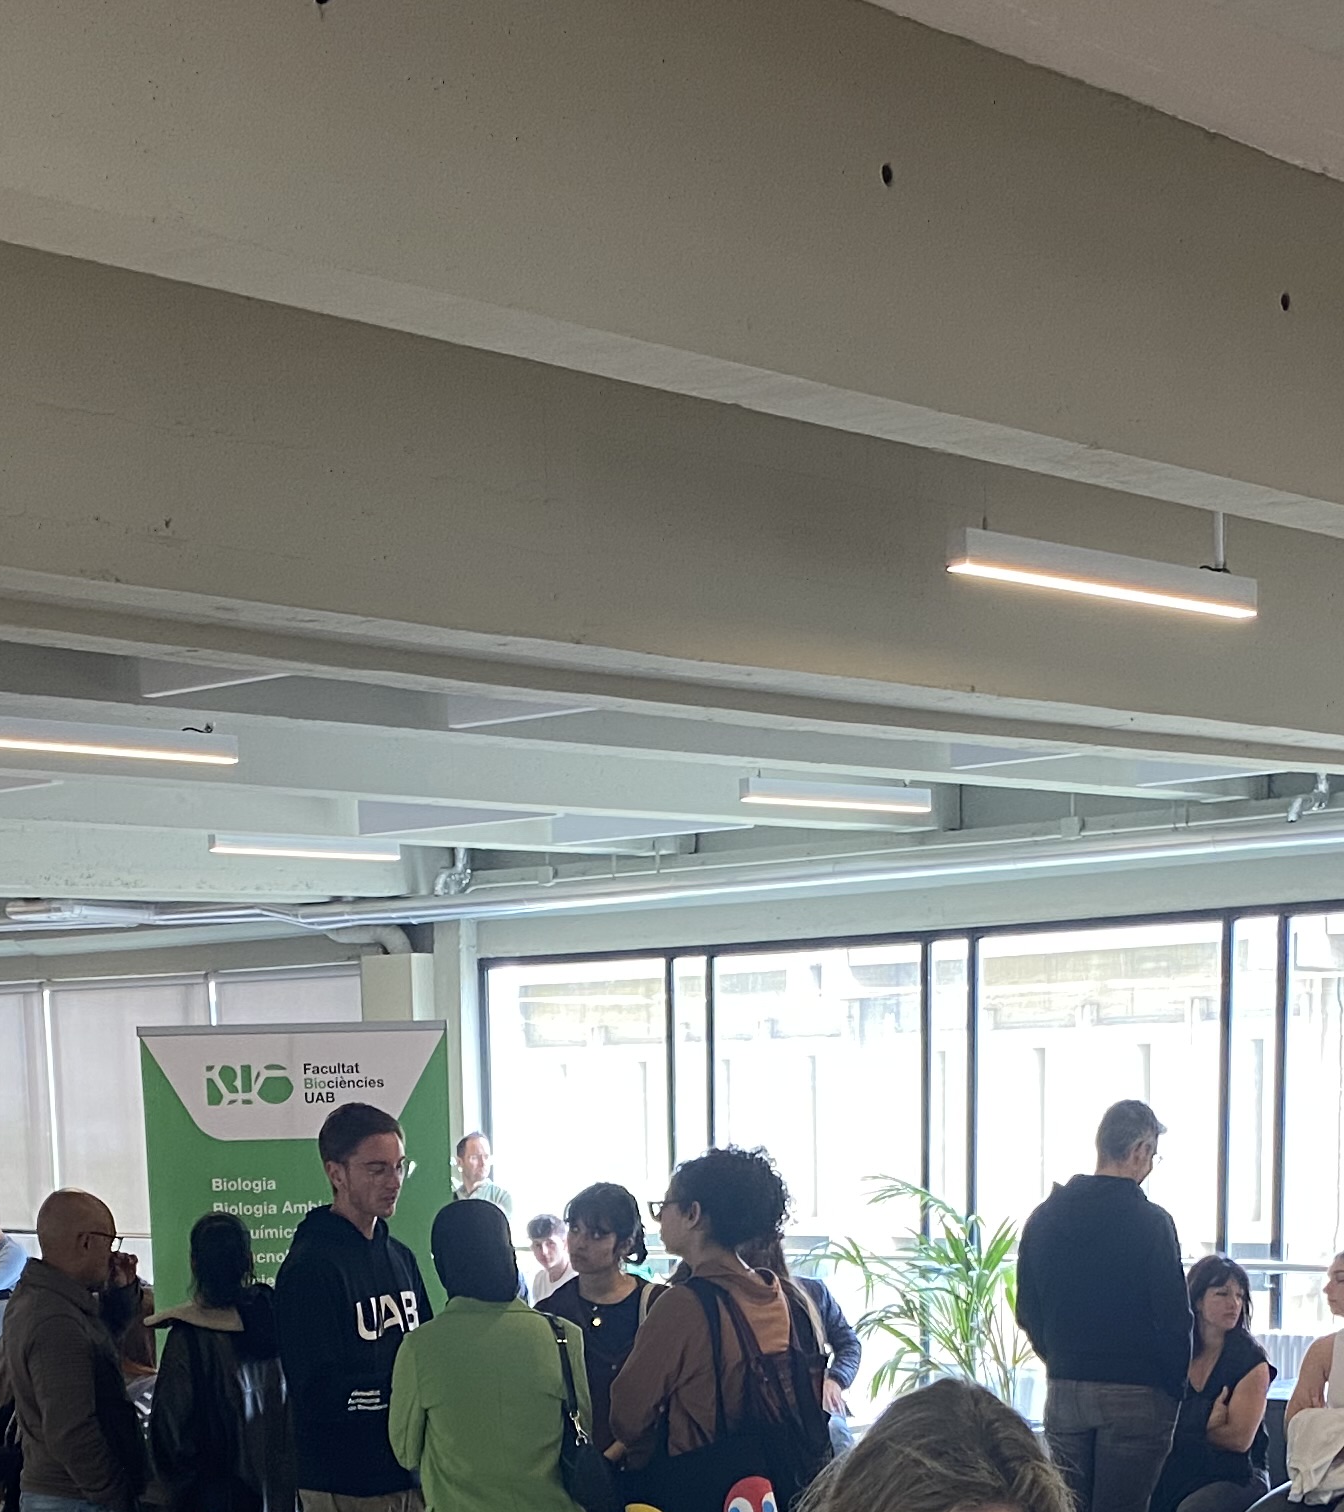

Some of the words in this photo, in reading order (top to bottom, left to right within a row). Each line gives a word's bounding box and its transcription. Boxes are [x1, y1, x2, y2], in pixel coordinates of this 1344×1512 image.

[303, 1063, 360, 1075] Facultat
[304, 1076, 385, 1089] Biociències
[304, 1092, 335, 1103] UAB
[212, 1177, 276, 1193] Biologia
[213, 1201, 277, 1217] Biologia
[356, 1290, 420, 1341] UAB
